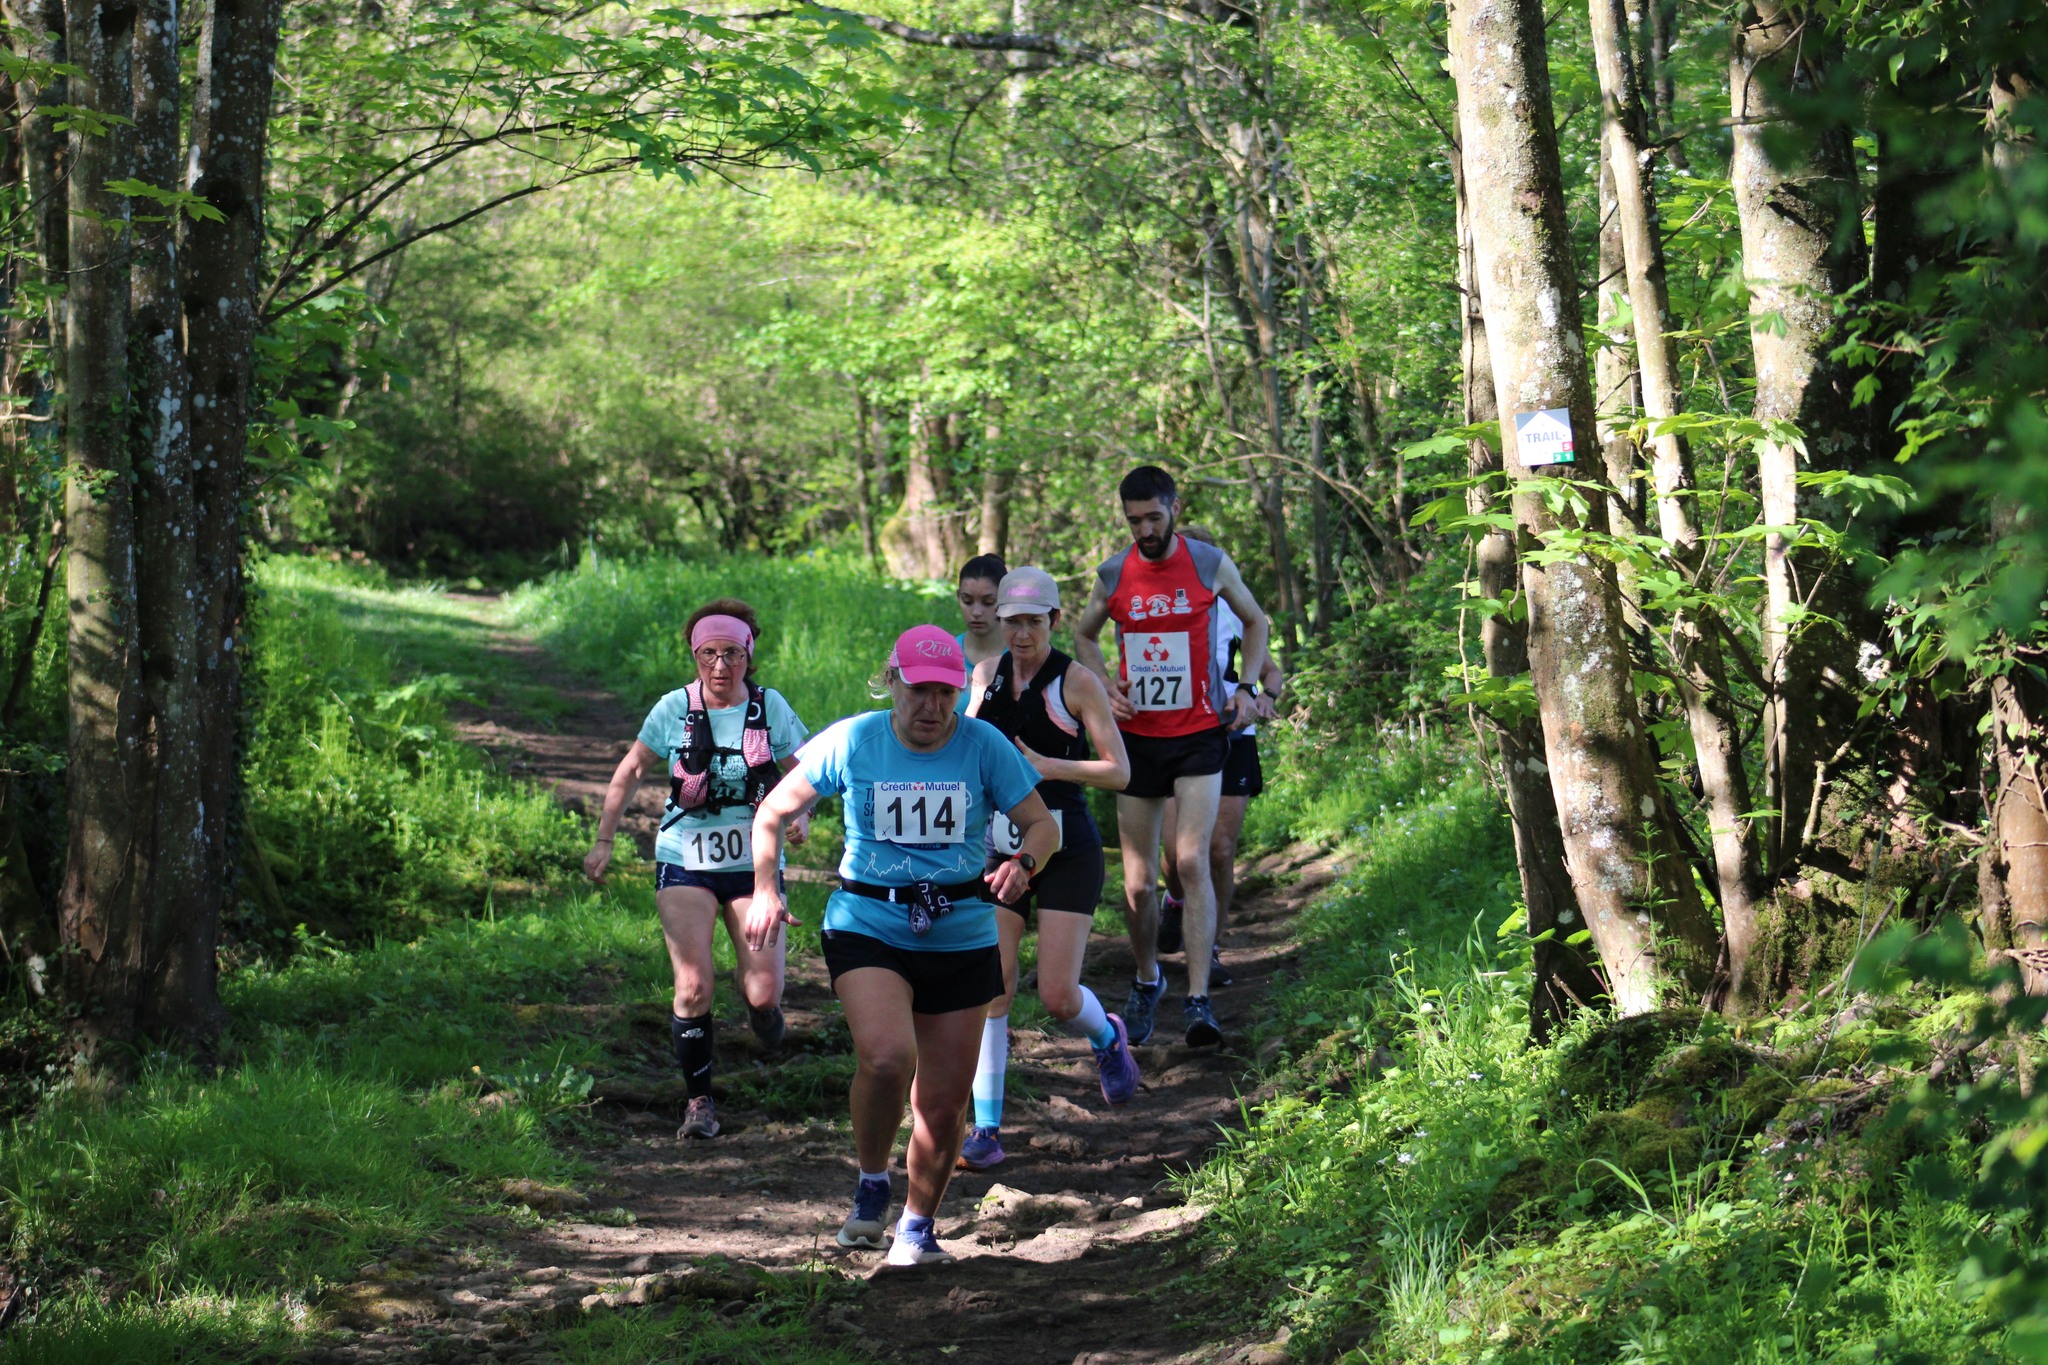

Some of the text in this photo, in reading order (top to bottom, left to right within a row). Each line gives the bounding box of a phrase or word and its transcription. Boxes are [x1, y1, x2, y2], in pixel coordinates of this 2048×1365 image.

[1525, 431, 1562, 443] TRAIL
[916, 639, 952, 658] Run
[1131, 664, 1186, 672] Crédit Mutuel
[1136, 676, 1182, 706] 127
[880, 782, 960, 791] Crédit Mutuel
[887, 796, 955, 836] 114
[691, 829, 743, 864] 130
[1008, 821, 1024, 850] 9
